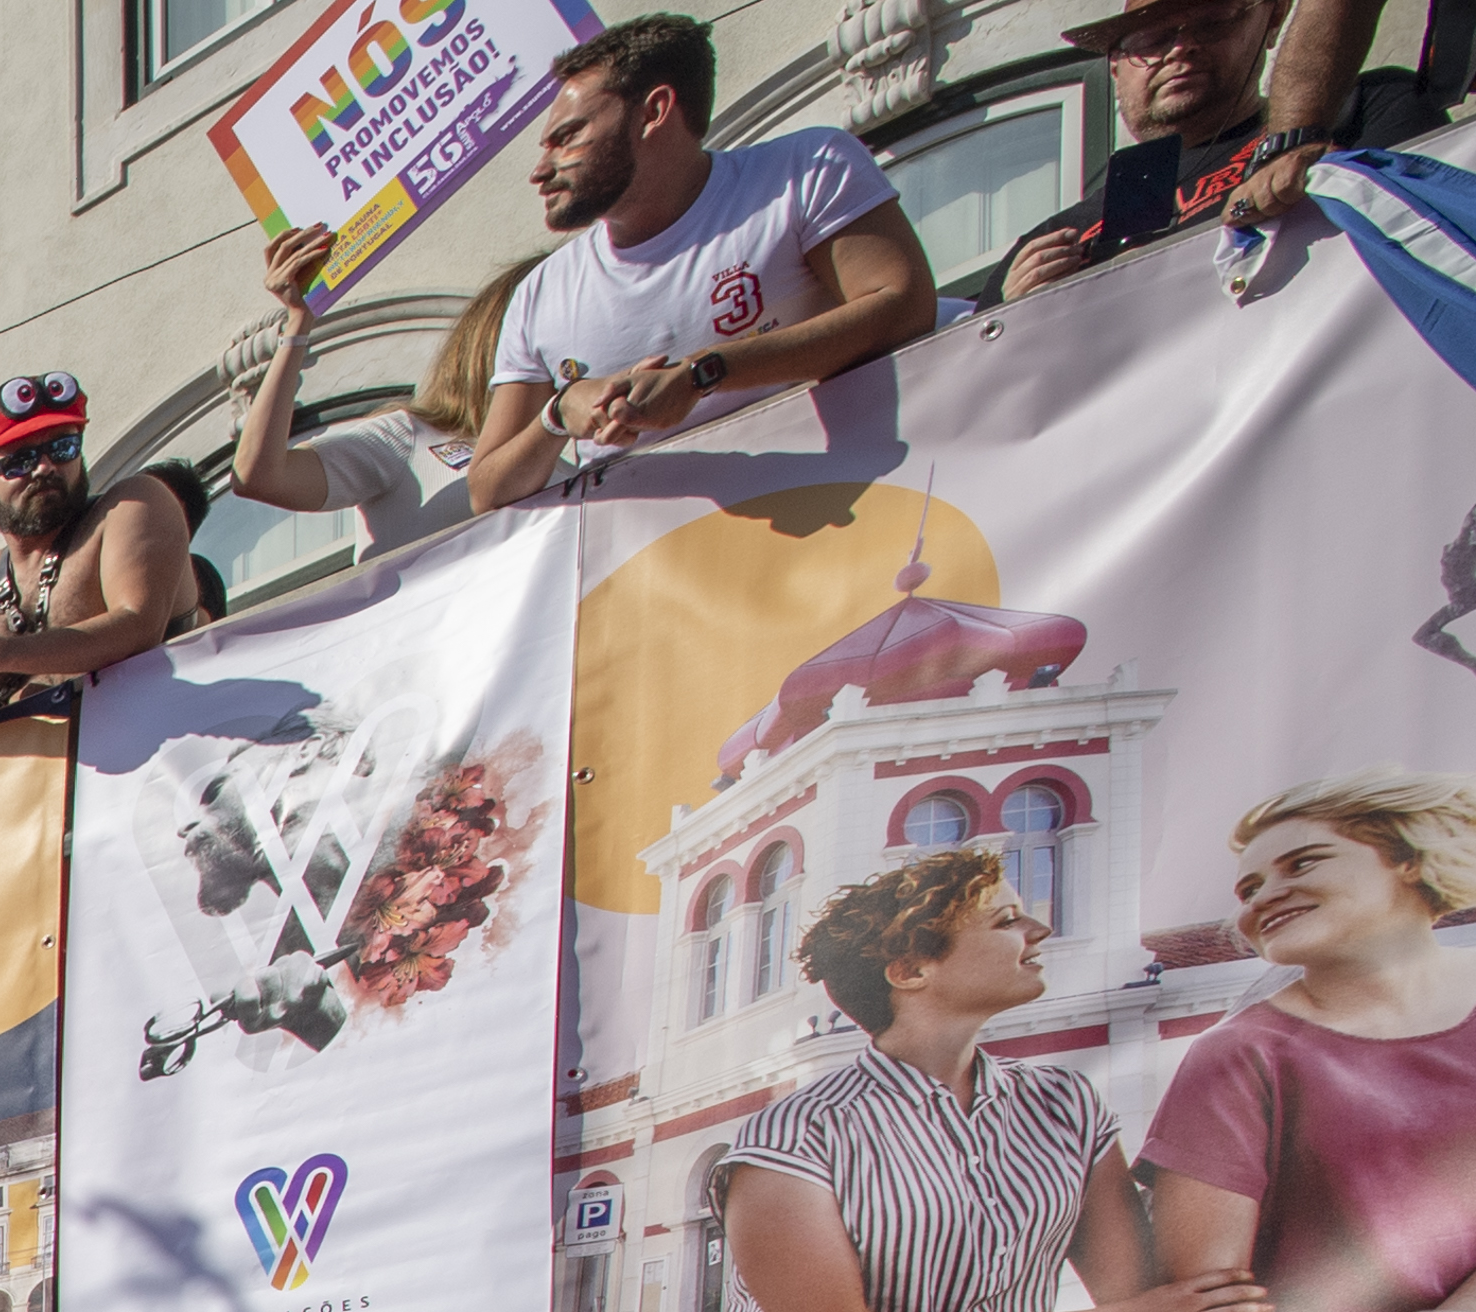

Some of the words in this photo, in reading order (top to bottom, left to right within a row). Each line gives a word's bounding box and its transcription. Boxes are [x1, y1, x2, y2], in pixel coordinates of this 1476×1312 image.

[289, 0, 466, 158] NÓS
[325, 18, 485, 178] PROMOVEMOS
[341, 176, 362, 202] A
[361, 38, 500, 178] INCLUSÃO!
[712, 261, 749, 282] VILLA
[711, 272, 764, 337] 3
[582, 1190, 609, 1199] zona
[582, 1203, 607, 1227] P
[577, 1230, 606, 1240] pago
